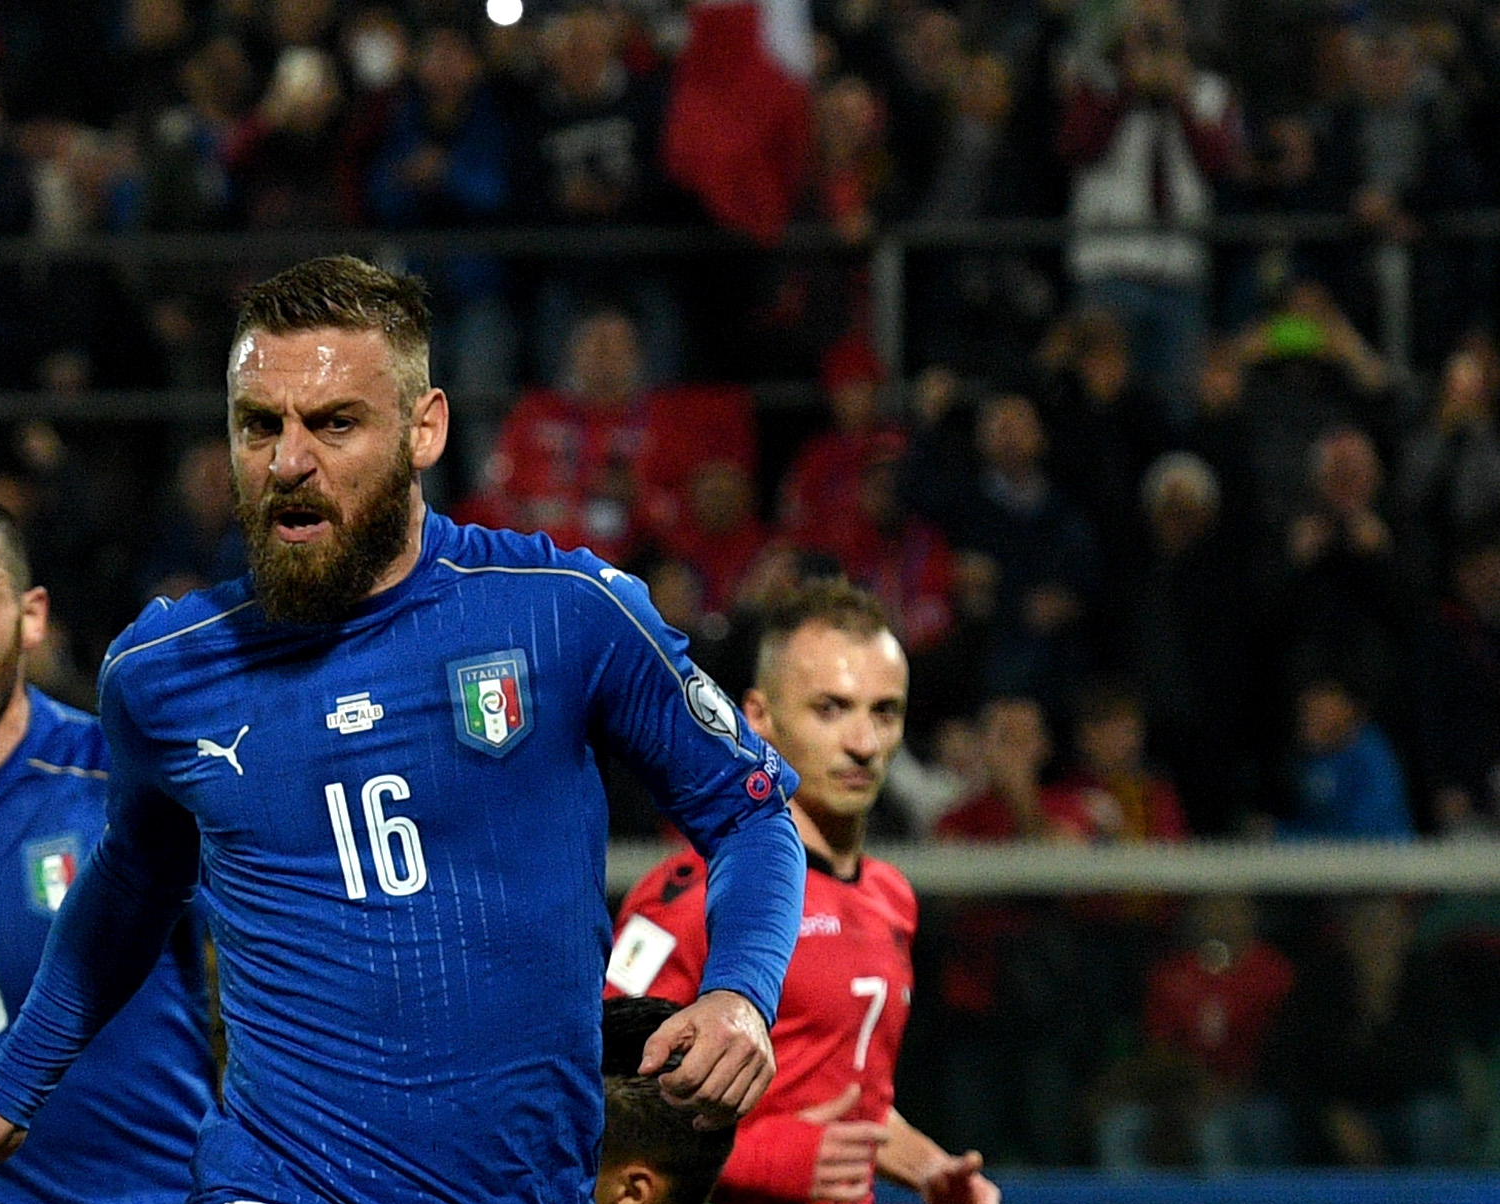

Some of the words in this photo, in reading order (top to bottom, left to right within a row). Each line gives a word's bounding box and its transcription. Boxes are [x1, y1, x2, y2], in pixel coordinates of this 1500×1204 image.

[466, 667, 509, 681] ITALIA
[328, 713, 346, 727] ITA
[360, 707, 381, 719] ALB
[324, 774, 428, 900] 16
[850, 975, 889, 1073] 7
